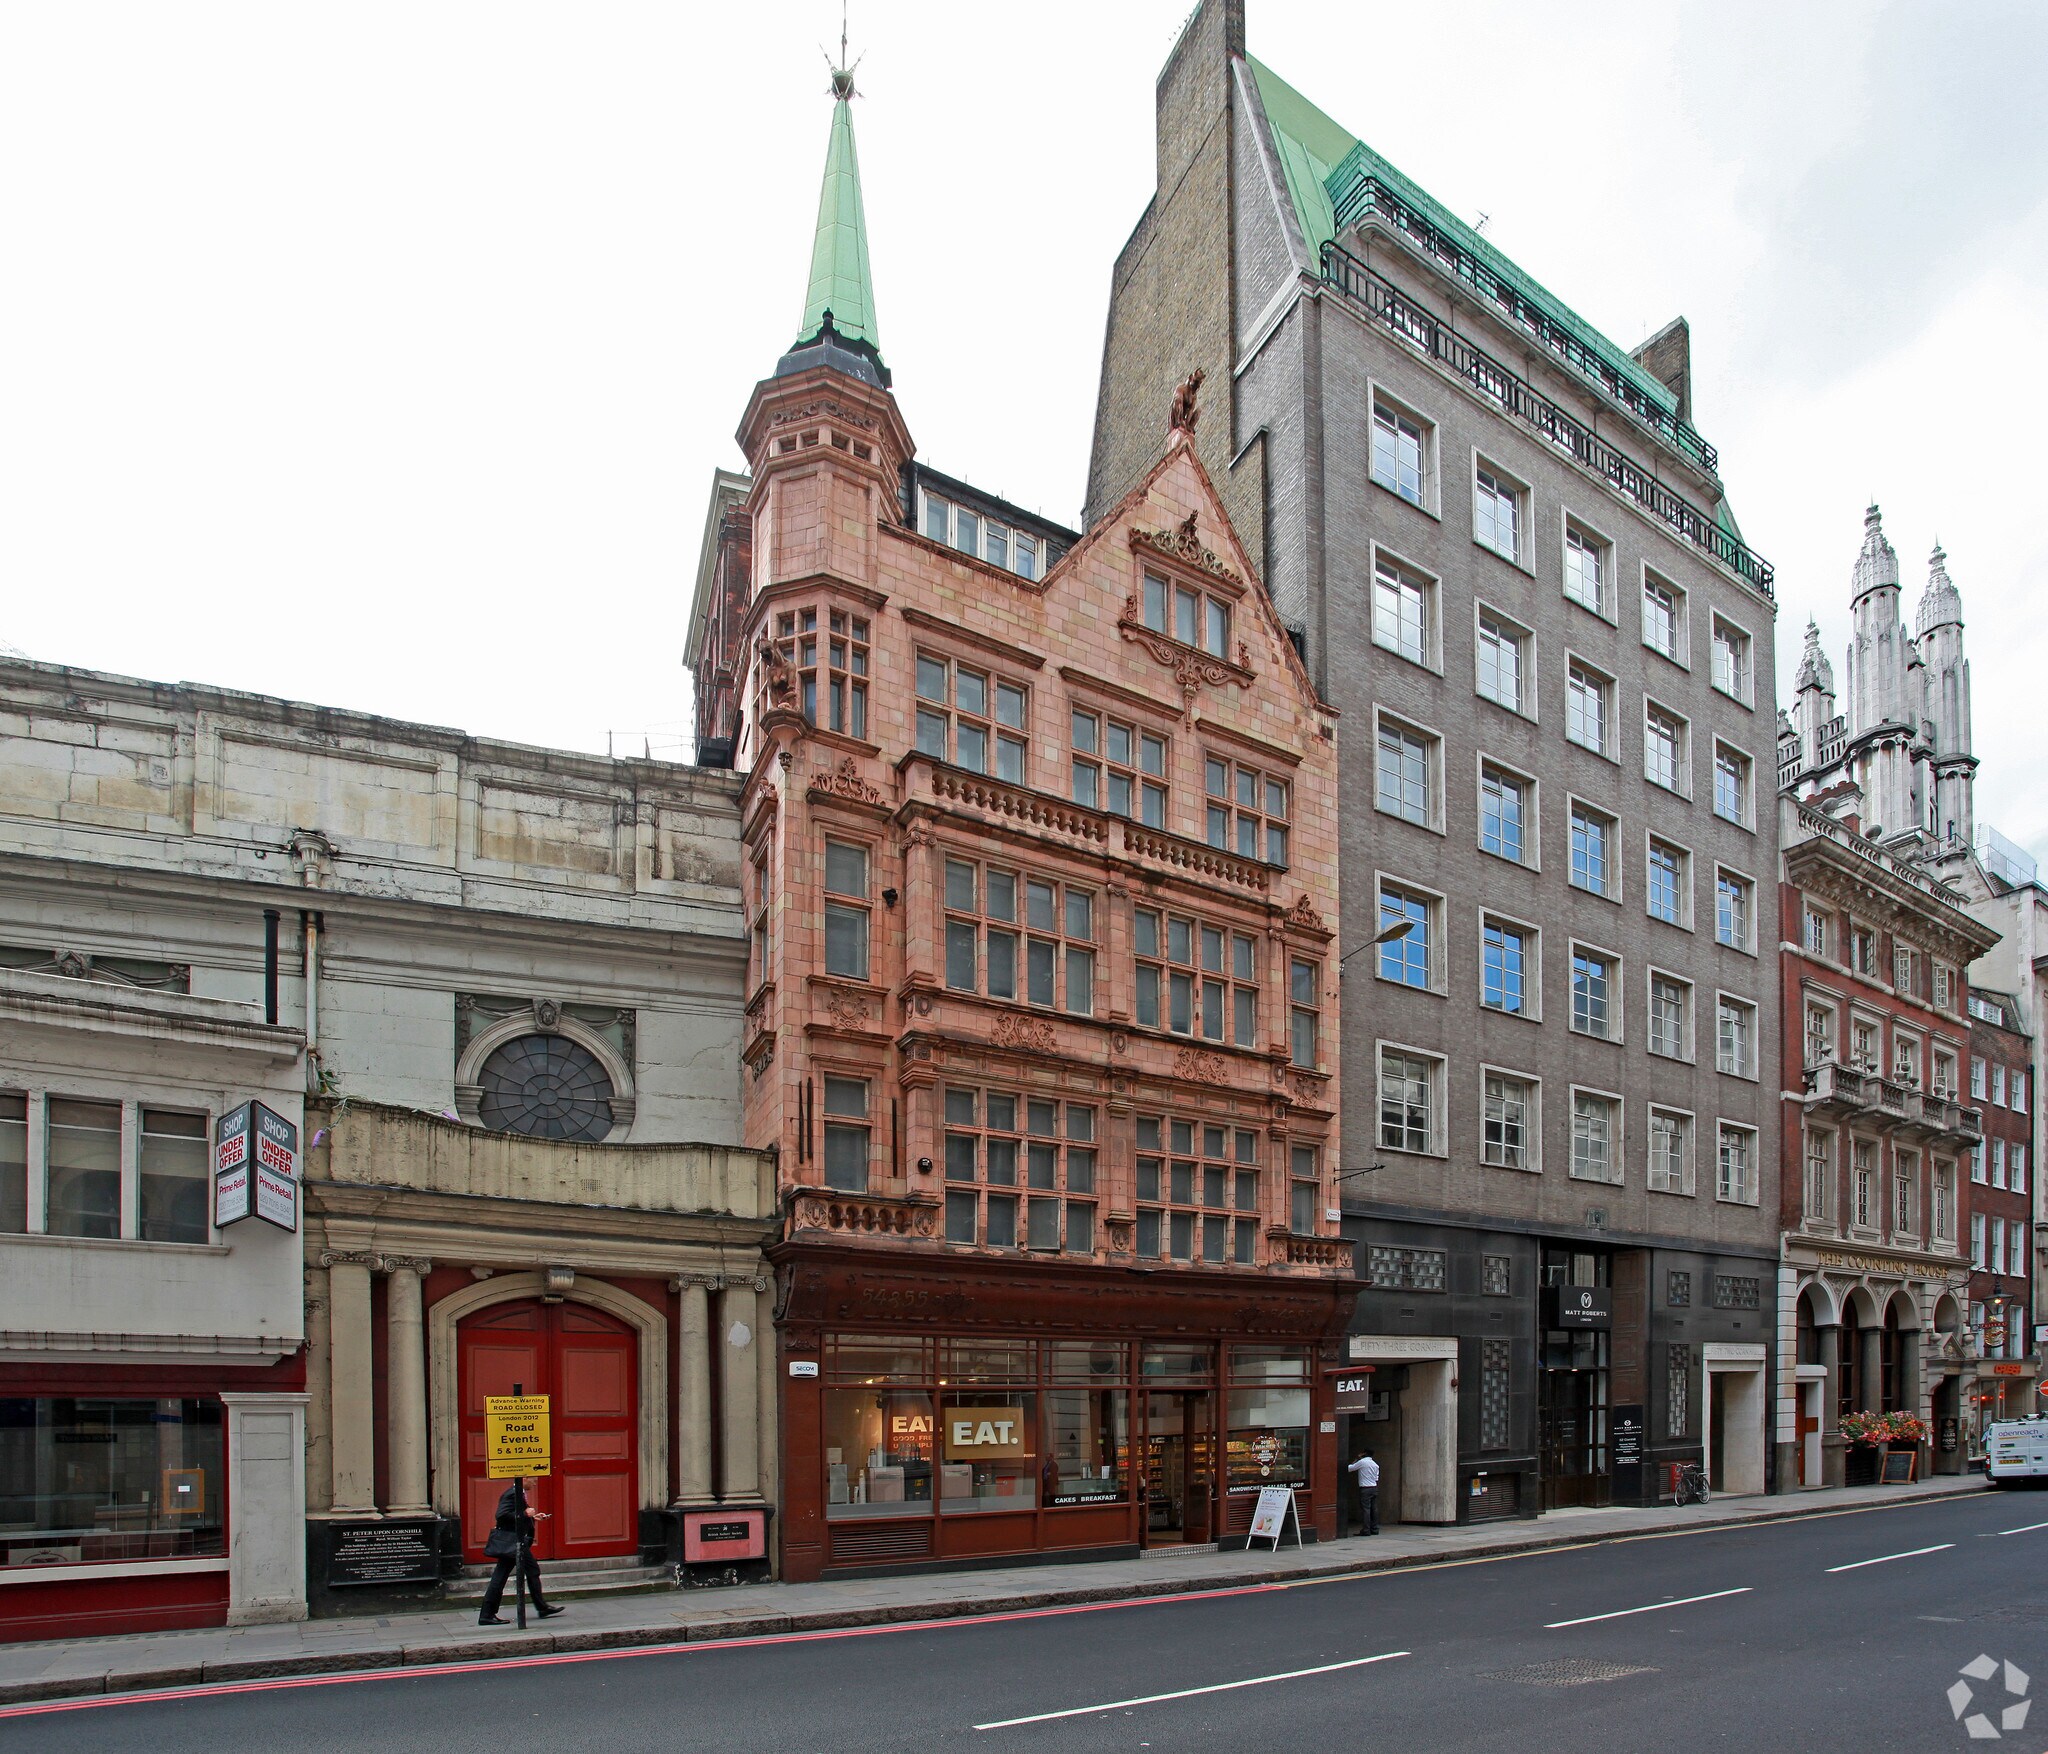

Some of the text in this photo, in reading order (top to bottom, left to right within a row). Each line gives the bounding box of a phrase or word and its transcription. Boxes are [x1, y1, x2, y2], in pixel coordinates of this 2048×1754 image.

[224, 1114, 243, 1137] SHOP
[264, 1116, 288, 1142] SHOP
[219, 1136, 243, 1157] UNDER
[262, 1137, 292, 1164] UNDER
[219, 1148, 243, 1169] OFFER
[262, 1151, 291, 1175] OFFER
[219, 1183, 233, 1196] Prime
[259, 1176, 274, 1192] Prime
[1817, 1251, 1948, 1278] THE COUNTING HOUSE
[1337, 1380, 1364, 1392] EAT.
[506, 1423, 534, 1431] Road
[953, 1421, 1018, 1446] EAT.
[501, 1435, 539, 1443] Events
